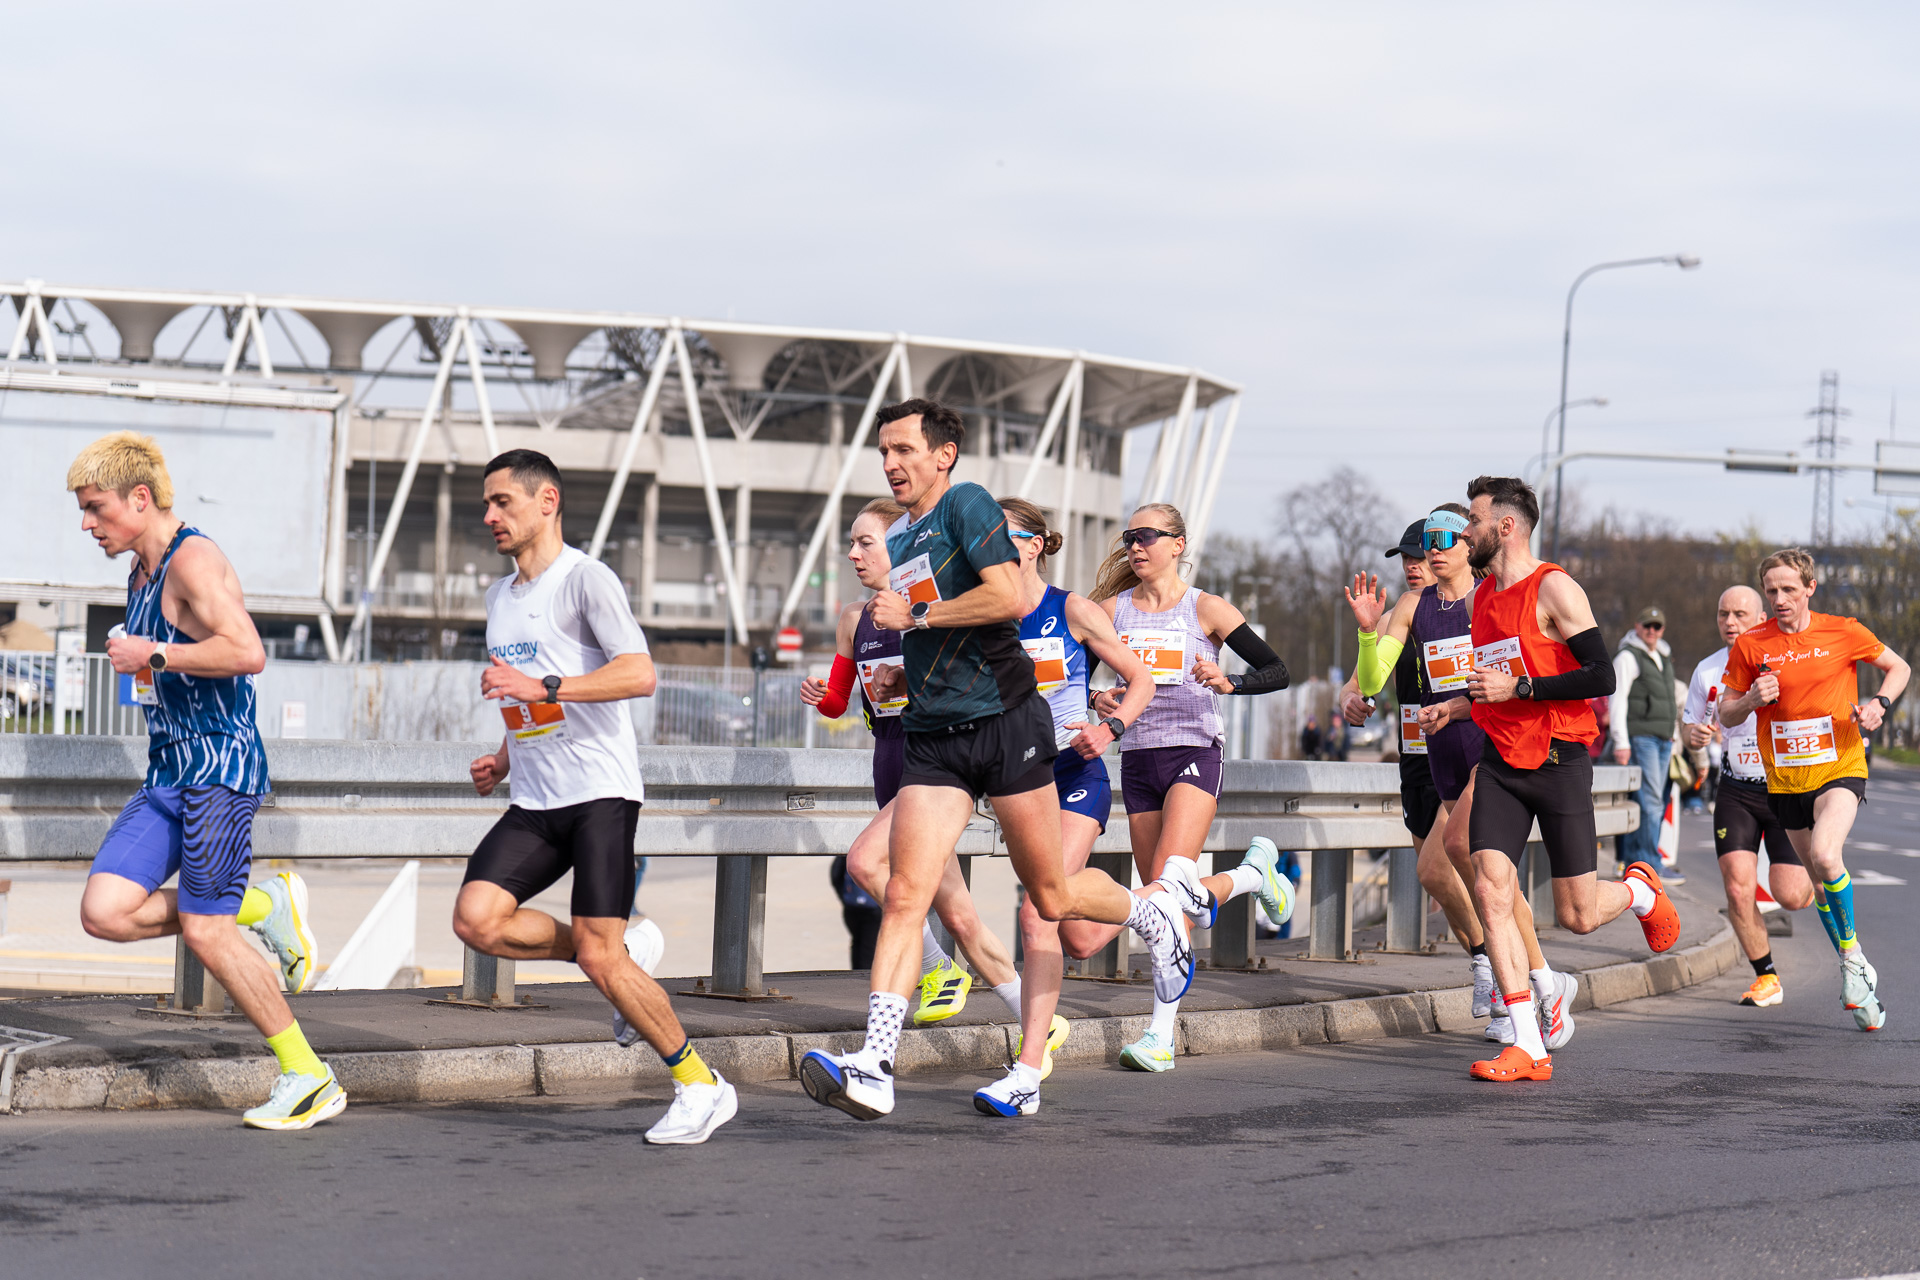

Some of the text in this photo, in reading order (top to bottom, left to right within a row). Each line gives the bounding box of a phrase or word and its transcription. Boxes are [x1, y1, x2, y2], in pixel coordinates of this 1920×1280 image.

[1137, 649, 1158, 665] 14
[1813, 647, 1830, 658] Run
[1450, 655, 1471, 671] 12
[519, 704, 533, 723] 9
[1787, 737, 1820, 753] 322
[1737, 752, 1763, 765] 173
